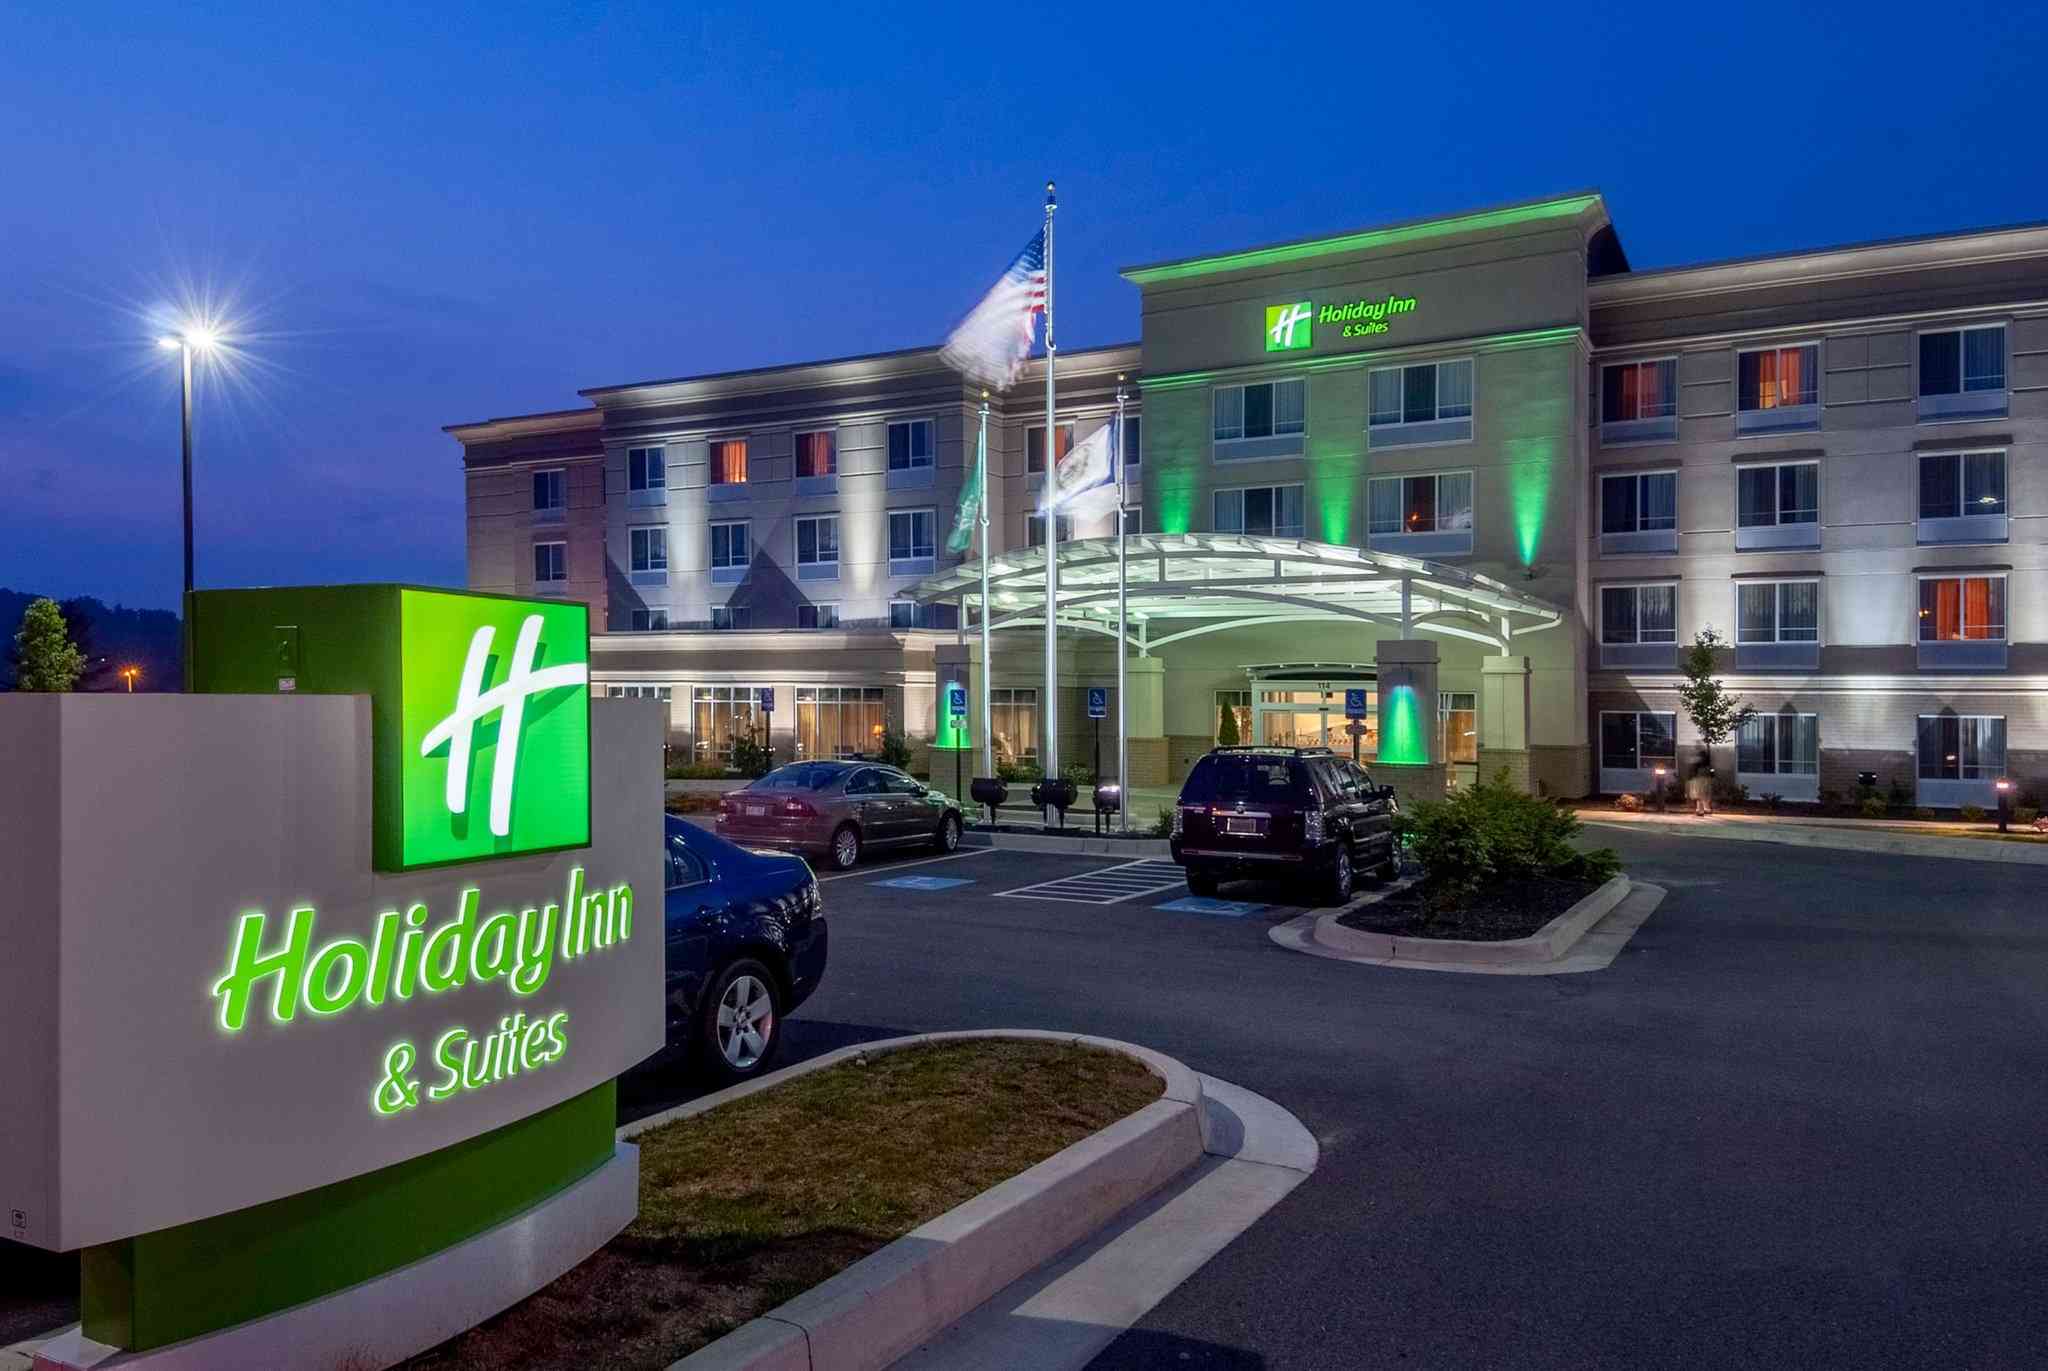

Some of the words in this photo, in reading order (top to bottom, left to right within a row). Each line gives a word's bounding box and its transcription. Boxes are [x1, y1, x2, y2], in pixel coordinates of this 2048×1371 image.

[1319, 301, 1387, 323] Holiday
[1387, 296, 1416, 313] Inn
[1342, 326, 1352, 338] &
[1354, 322, 1388, 336] Suites
[213, 887, 559, 1031] Holiday
[562, 867, 633, 958] Inn
[374, 1042, 420, 1114] &
[429, 1012, 569, 1100] Suites
